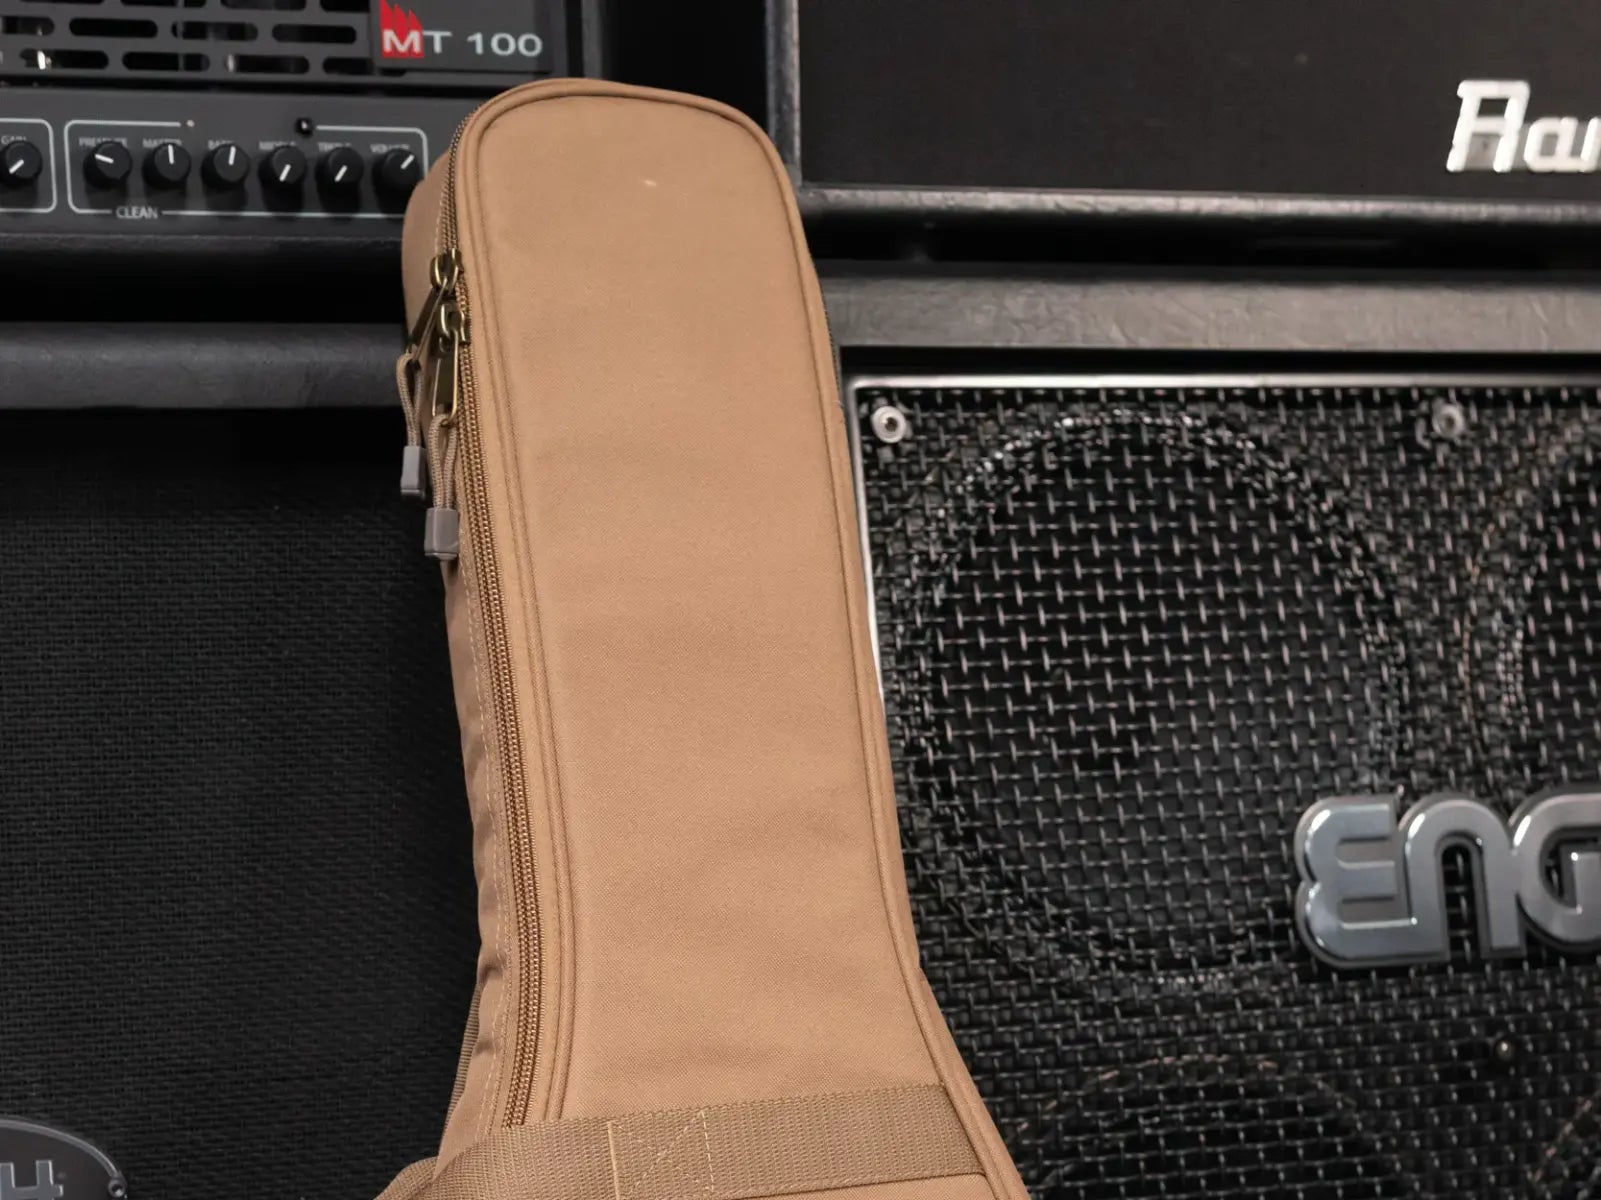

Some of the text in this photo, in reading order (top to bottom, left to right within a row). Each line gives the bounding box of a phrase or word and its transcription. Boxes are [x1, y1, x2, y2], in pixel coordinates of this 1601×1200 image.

[382, 29, 543, 57] MT 100
[115, 206, 158, 219] CLEAN
